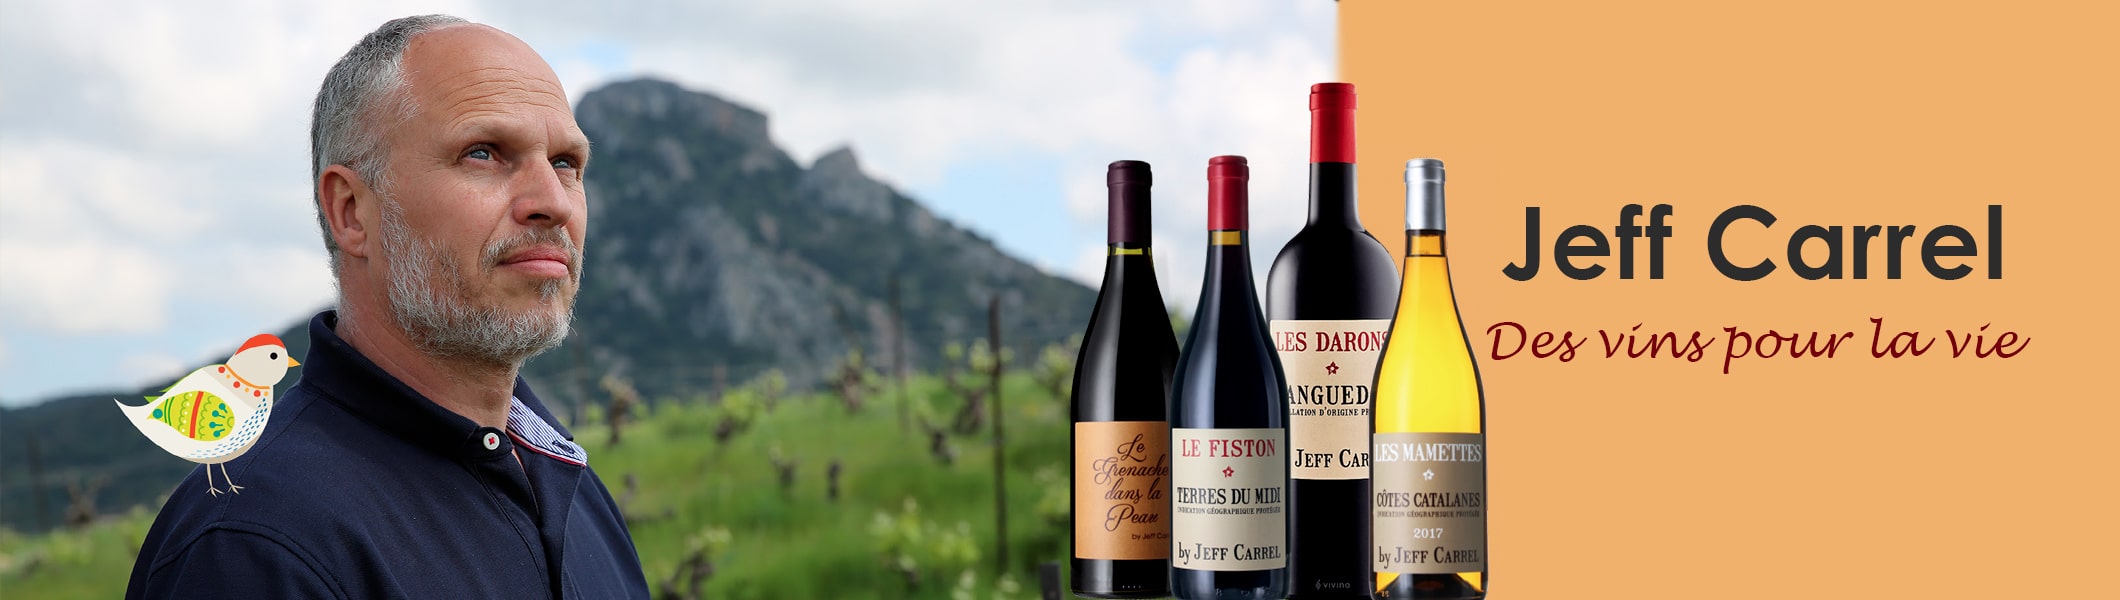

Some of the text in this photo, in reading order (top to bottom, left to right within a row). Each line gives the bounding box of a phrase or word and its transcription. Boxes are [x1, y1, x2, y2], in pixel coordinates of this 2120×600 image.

[1276, 331, 1307, 352] LES
[1319, 406, 1359, 416] D'ORIGINE
[1117, 433, 1147, 462] Le
[1182, 439, 1276, 458] LE FISTON
[1375, 442, 1481, 462] LES MAMETTES
[1093, 454, 1169, 486] Grenache
[1105, 477, 1163, 504] dans la
[1177, 487, 1281, 505] TERRES DU MIDI
[1376, 489, 1481, 508] CÔTES CATALANES
[1104, 503, 1159, 532] Peau
[1413, 528, 1444, 539] 2017
[1178, 541, 1191, 565] by
[1378, 546, 1391, 569] by
